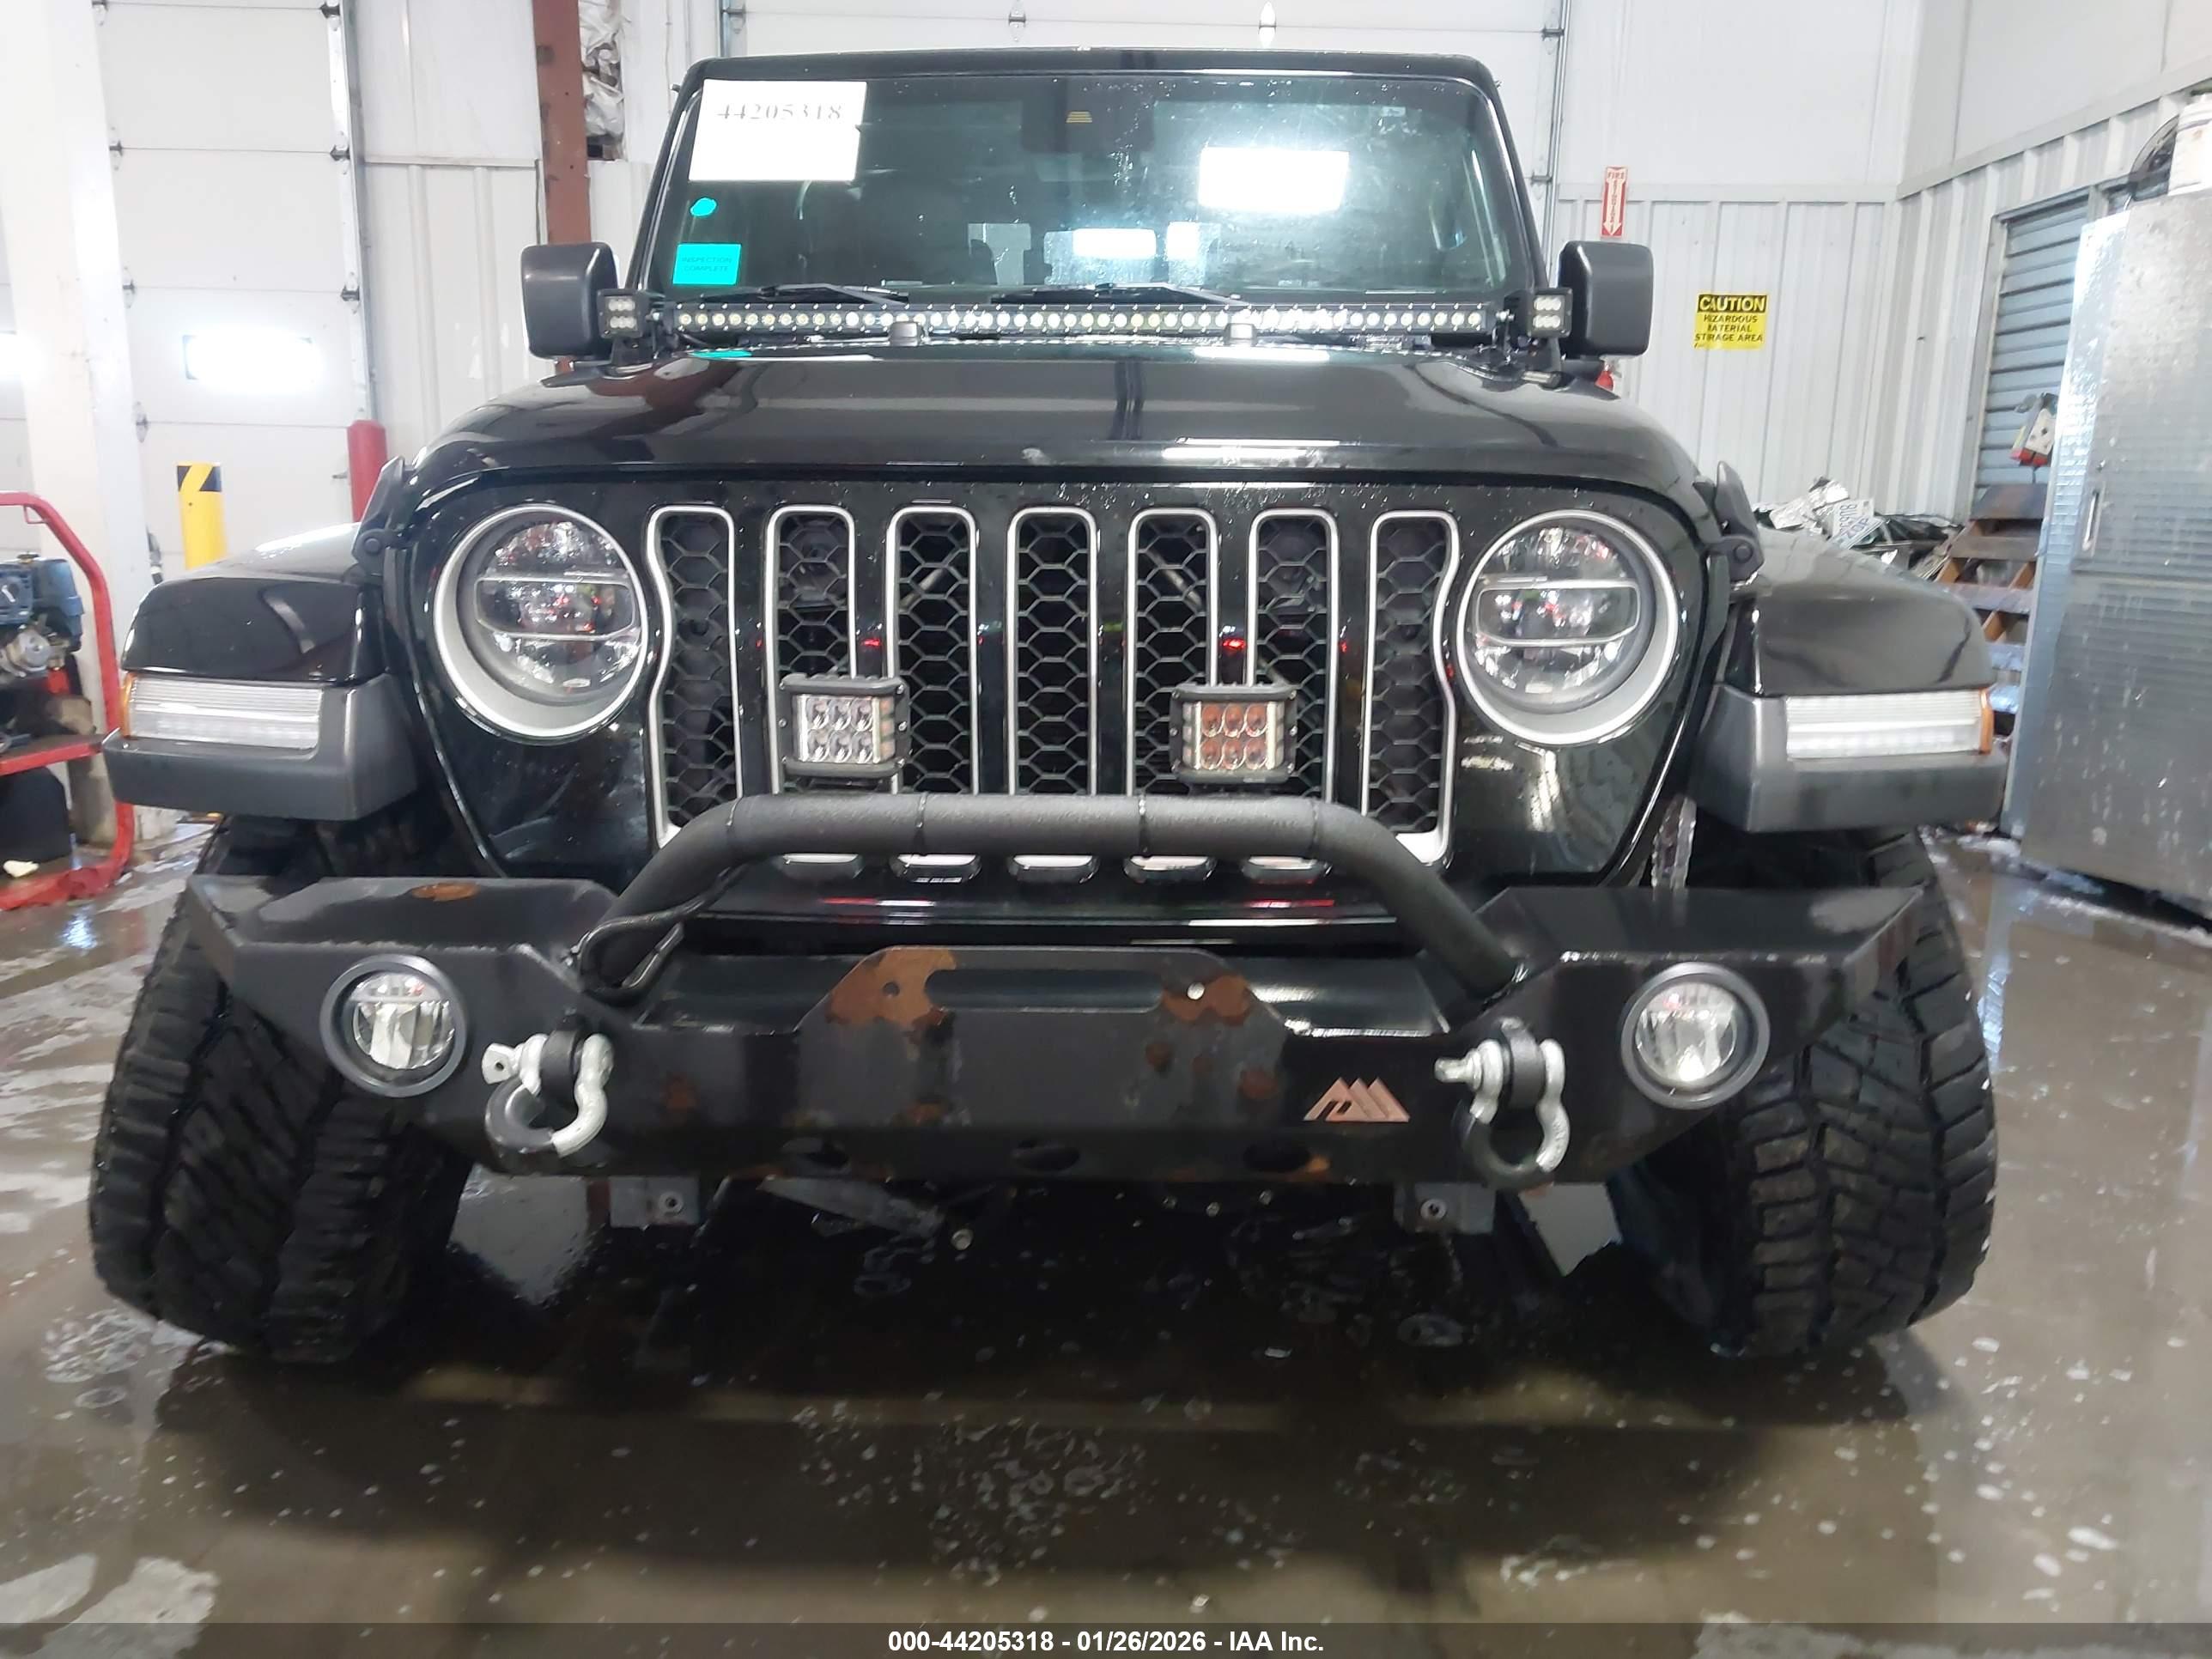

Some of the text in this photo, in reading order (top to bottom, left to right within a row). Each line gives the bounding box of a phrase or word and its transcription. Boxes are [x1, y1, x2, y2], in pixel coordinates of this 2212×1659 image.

[716, 103, 842, 120] 44205318
[1699, 296, 1765, 312] CAUTION
[1737, 334, 1763, 343] AREA
